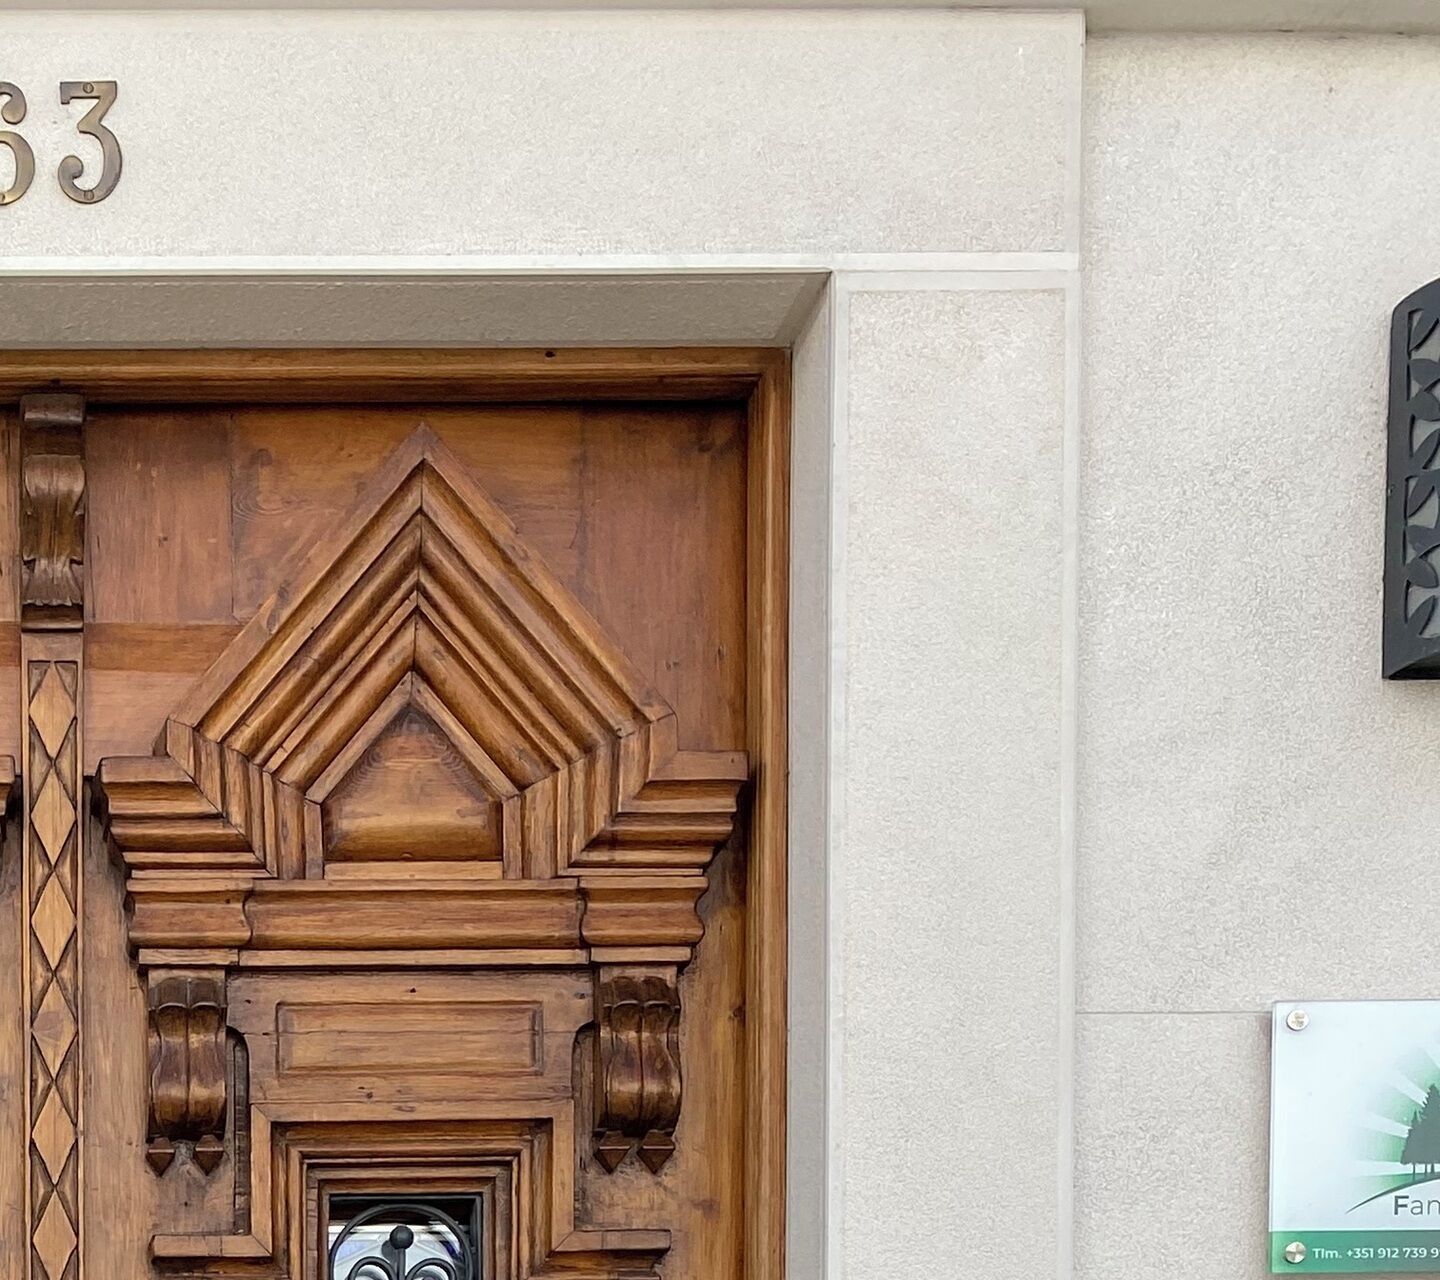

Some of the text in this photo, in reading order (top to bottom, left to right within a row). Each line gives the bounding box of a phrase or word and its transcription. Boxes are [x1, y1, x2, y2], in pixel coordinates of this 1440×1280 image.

[1346, 1247, 1374, 1259] +351
[1377, 1247, 1399, 1259] 912
[1403, 1247, 1427, 1259] 739
[1430, 1247, 1440, 1259] 9
